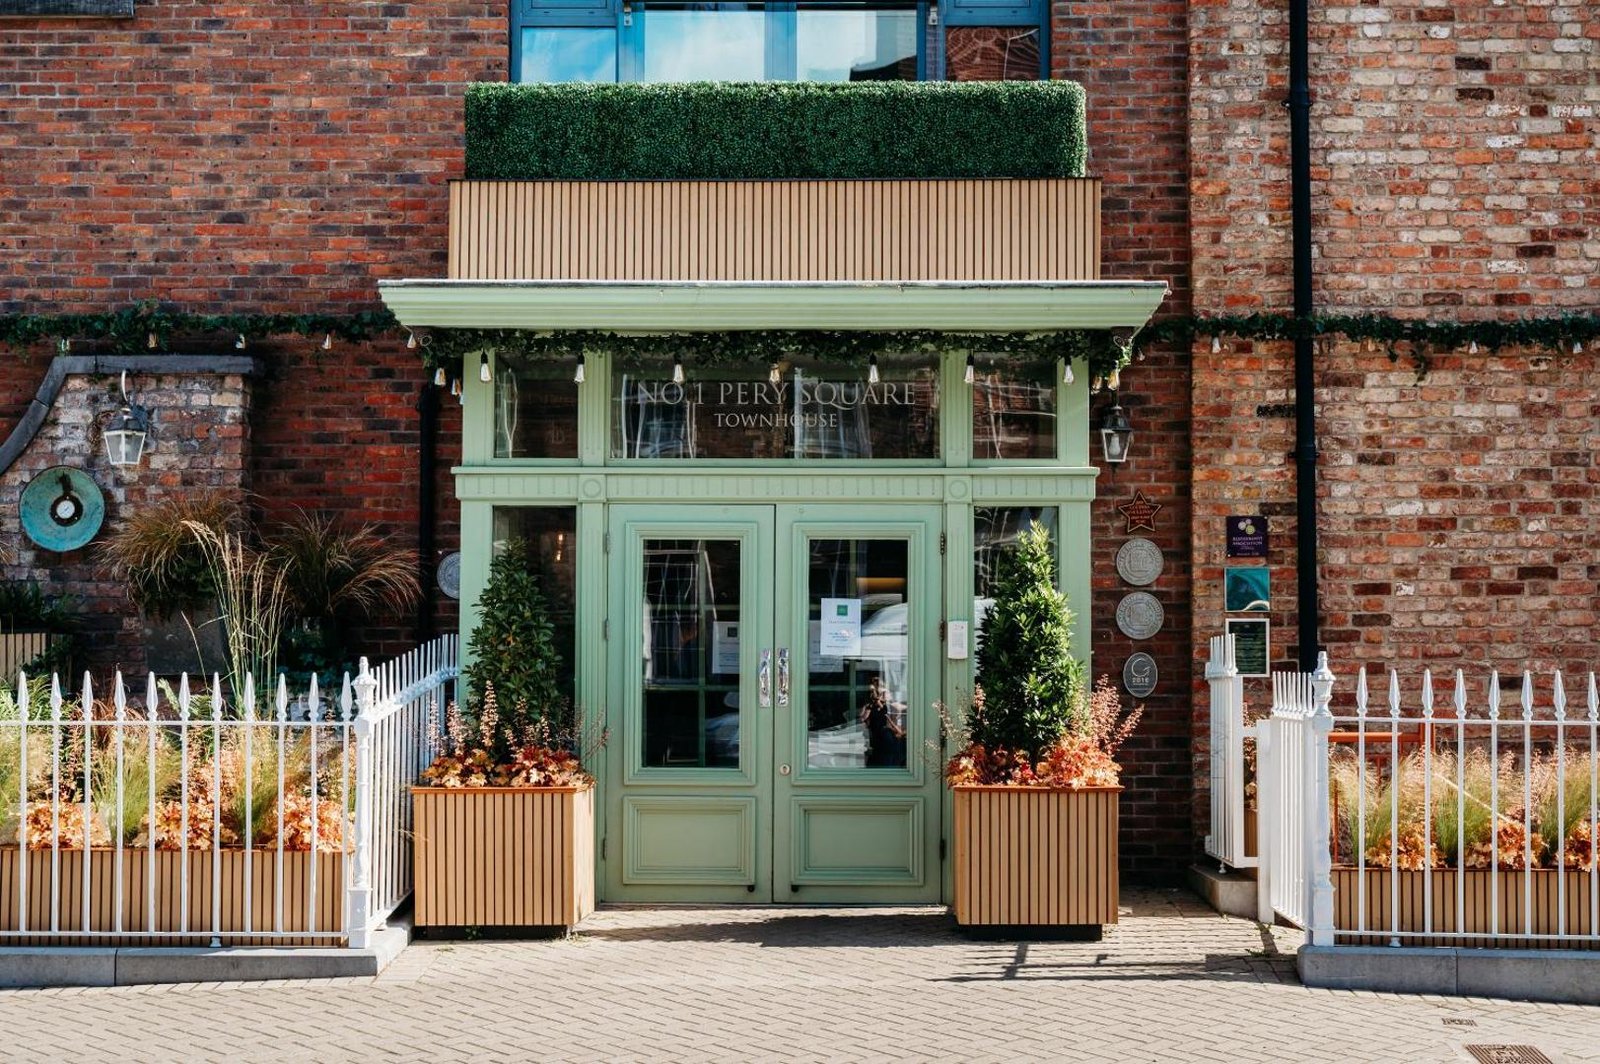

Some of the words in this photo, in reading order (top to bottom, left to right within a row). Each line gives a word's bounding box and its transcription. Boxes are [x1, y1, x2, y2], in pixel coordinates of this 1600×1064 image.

[718, 382, 788, 405] PERY
[800, 382, 916, 411] SQUARE
[714, 413, 837, 428] TOWNHOUSE
